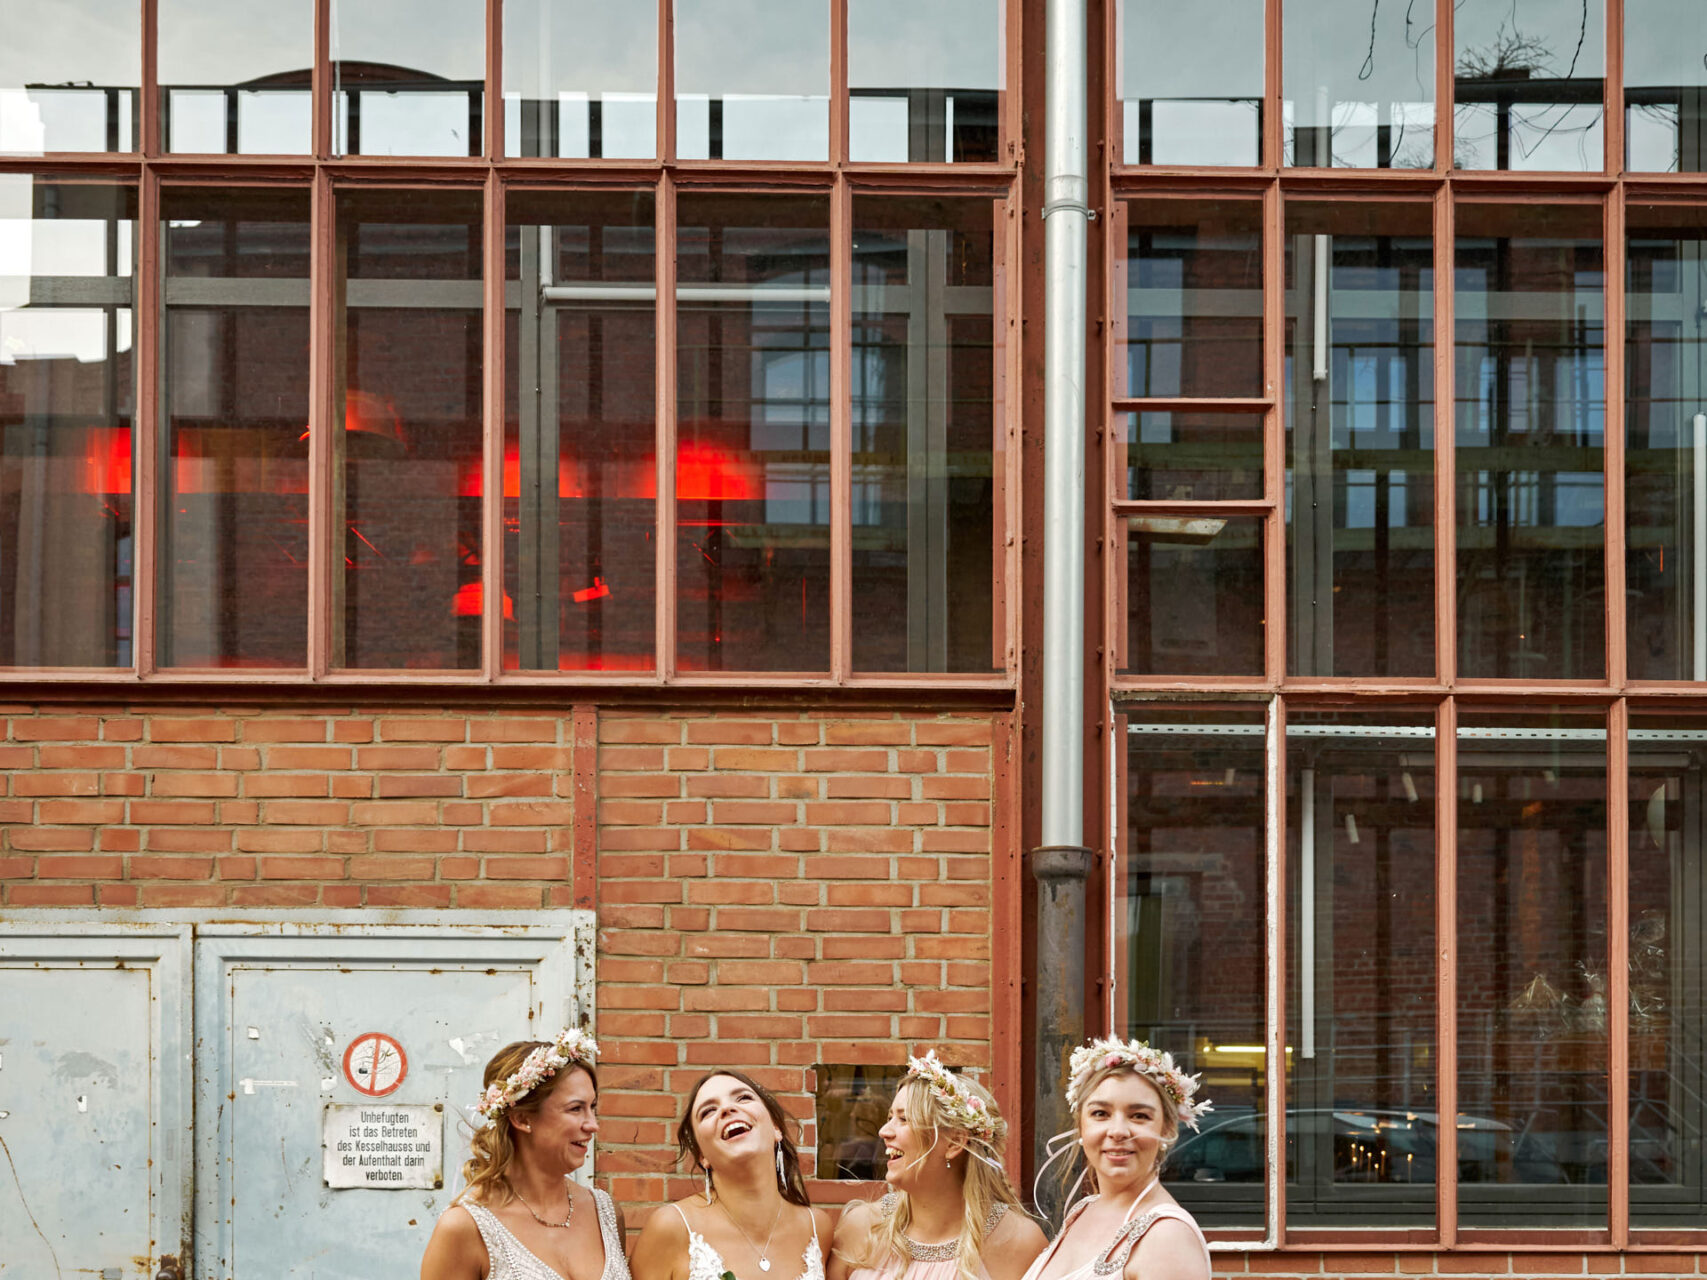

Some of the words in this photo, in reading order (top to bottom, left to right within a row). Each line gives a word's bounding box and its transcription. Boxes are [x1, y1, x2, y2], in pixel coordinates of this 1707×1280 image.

[361, 1112, 409, 1125] Unbefugten
[349, 1125, 360, 1137] ist
[363, 1126, 378, 1137] das
[382, 1126, 418, 1138] Betreten
[337, 1140, 352, 1151] des
[355, 1140, 413, 1152] Kesselhauses
[416, 1141, 431, 1152] und
[342, 1154, 356, 1166] der
[359, 1155, 402, 1166] Aufenthalt
[404, 1155, 425, 1166] darin
[365, 1170, 403, 1181] verboten
